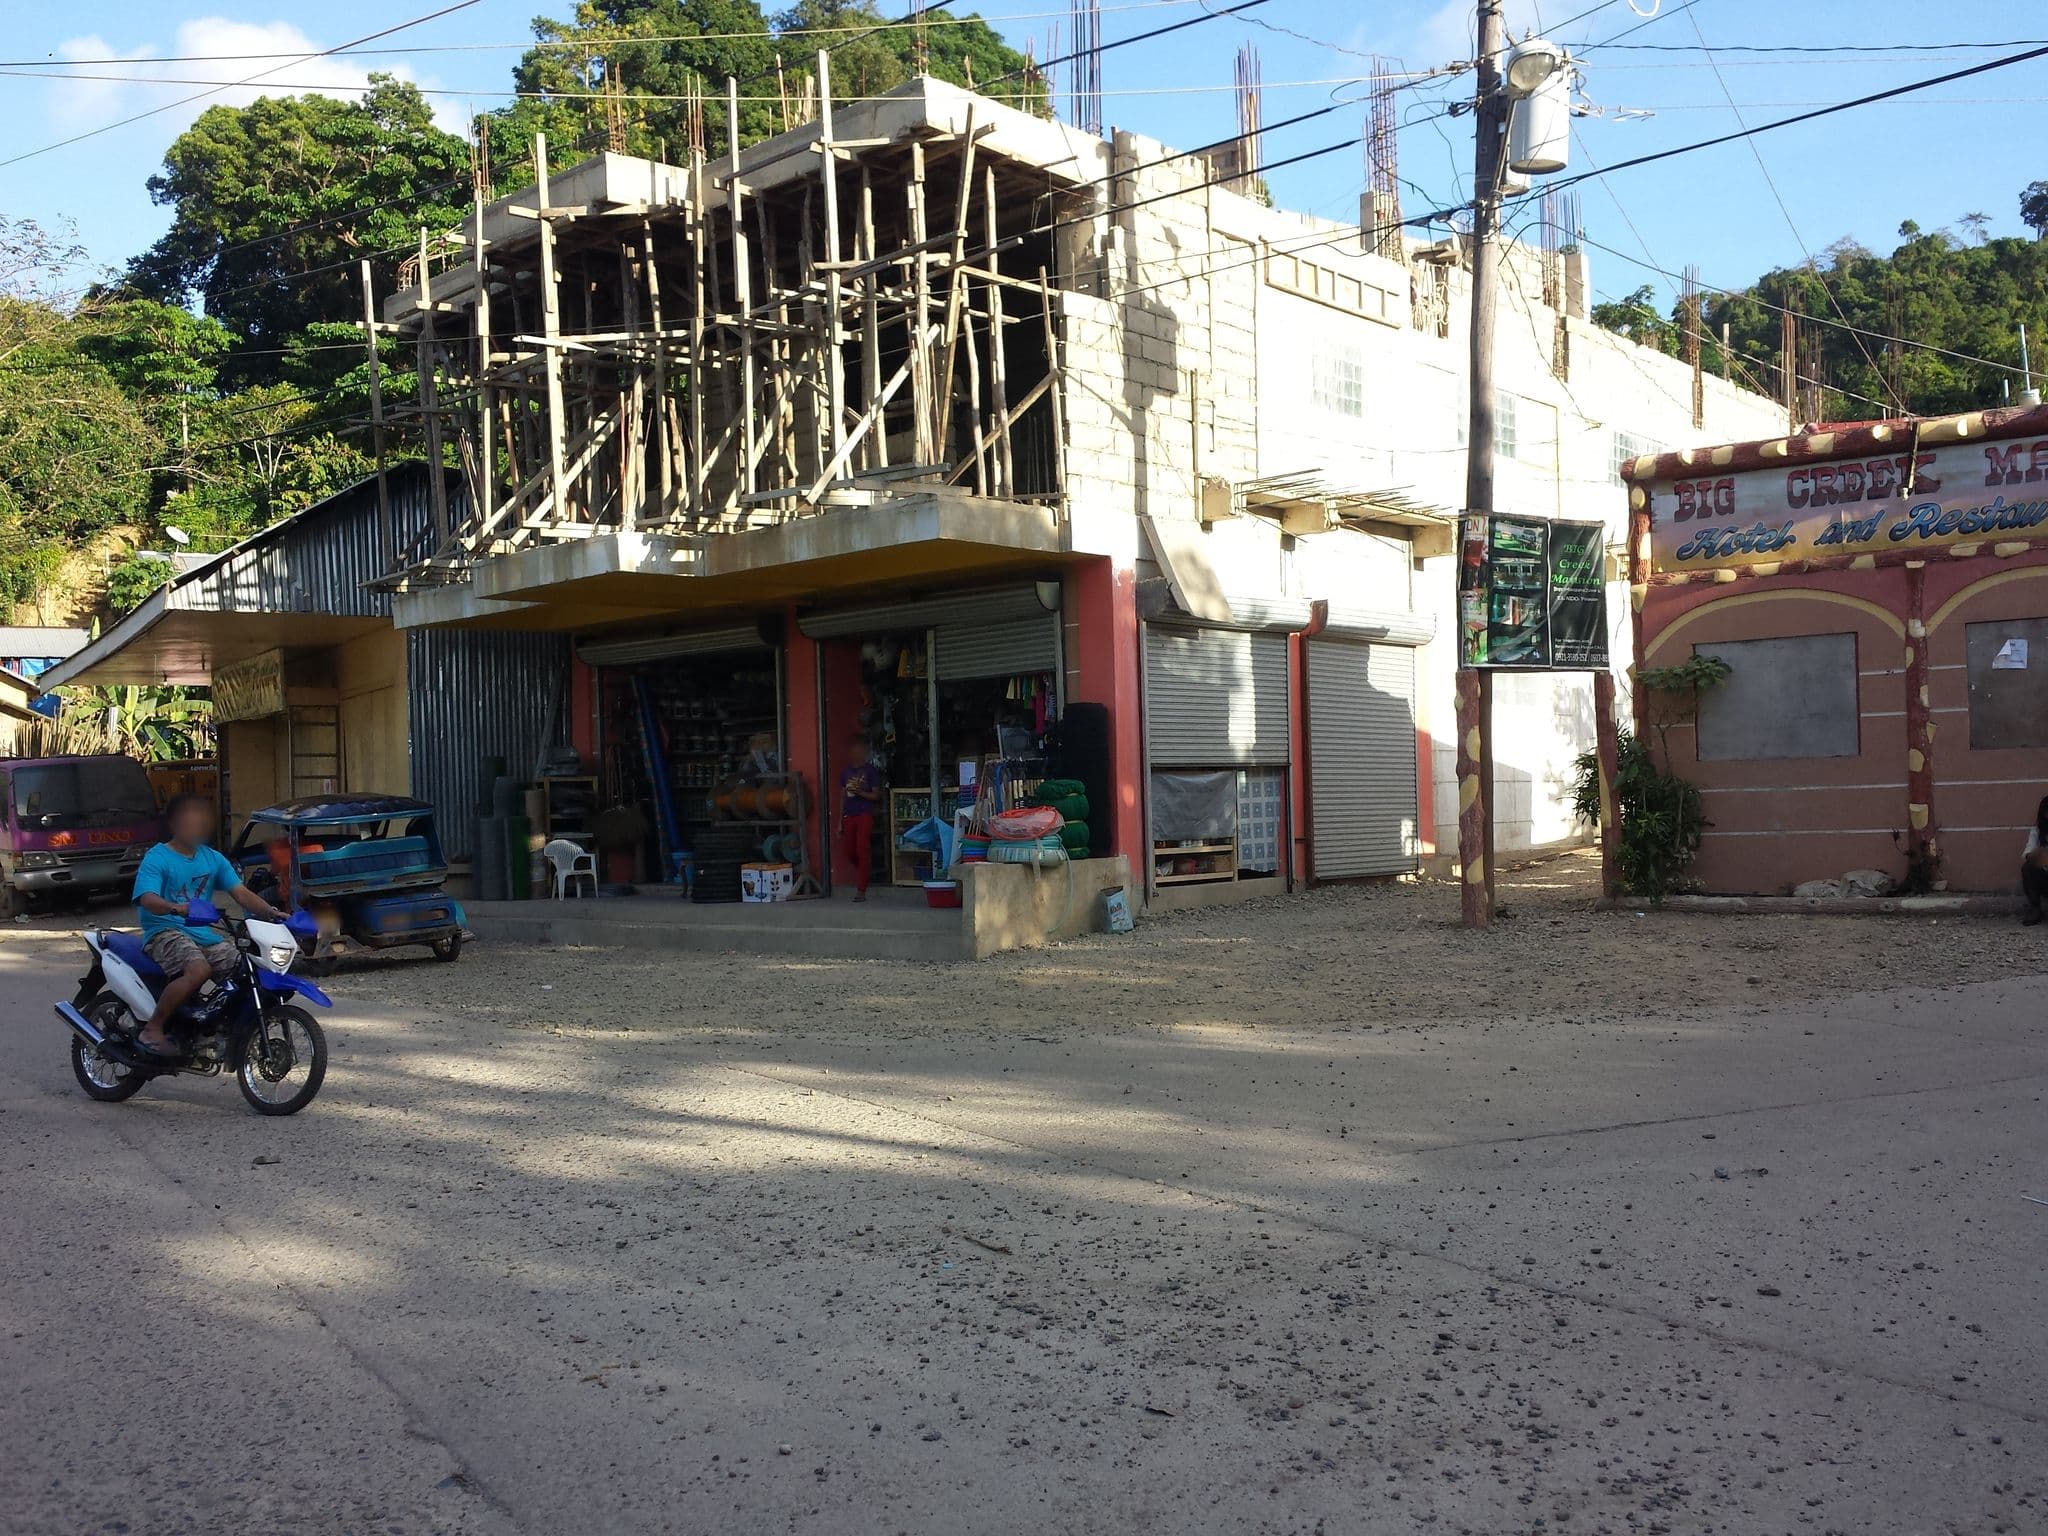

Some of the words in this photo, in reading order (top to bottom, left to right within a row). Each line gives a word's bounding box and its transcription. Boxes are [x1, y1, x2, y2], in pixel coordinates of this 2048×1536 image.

[1674, 478, 1735, 522] BIG
[1786, 453, 1941, 509] CREEK
[1676, 520, 1795, 562] Hotel
[1813, 510, 1883, 546] and
[1563, 543, 1585, 556] BIG
[1559, 558, 1591, 570] Creek
[1551, 574, 1601, 586] Mansion
